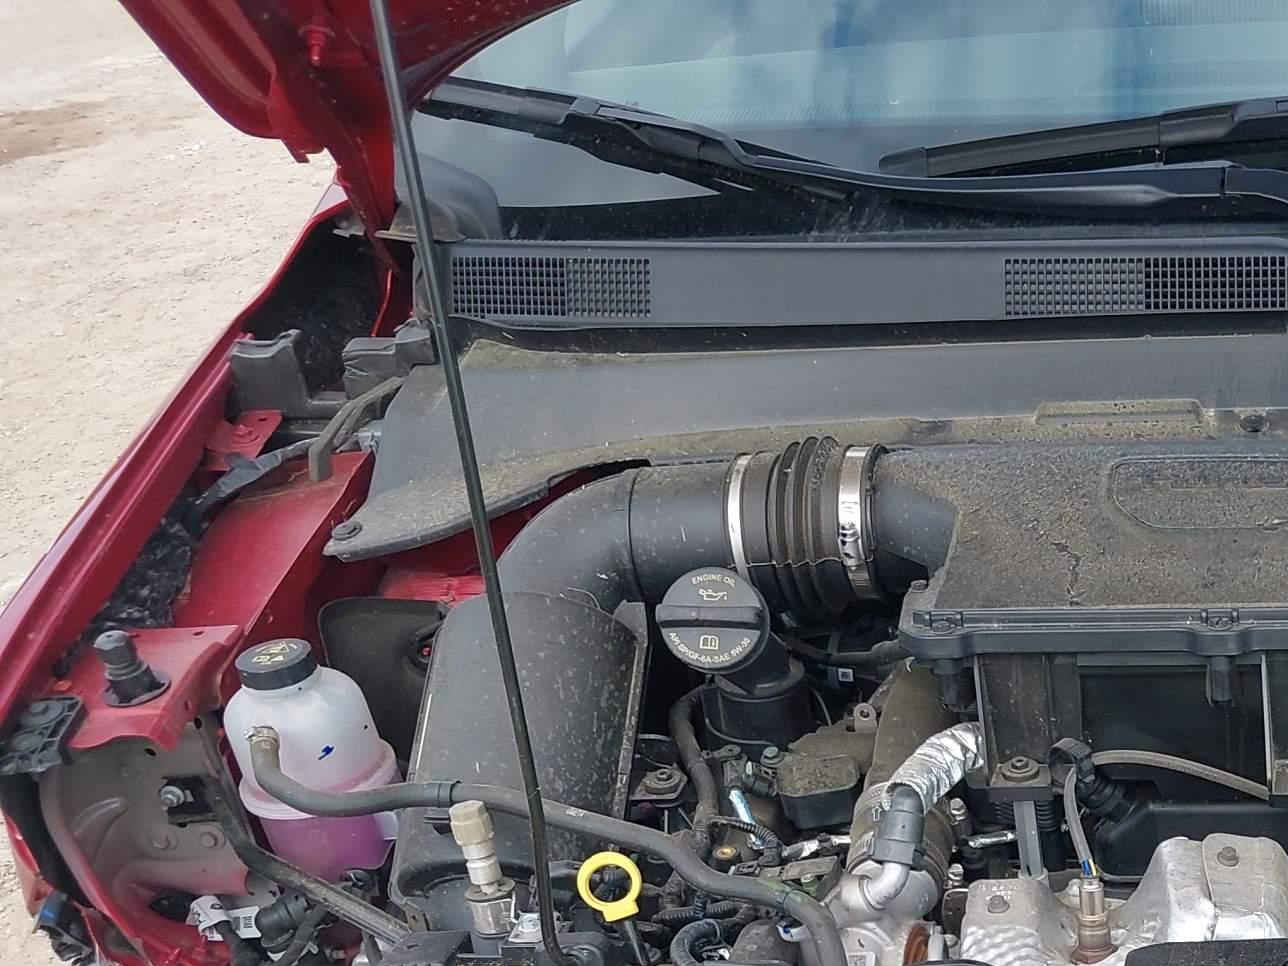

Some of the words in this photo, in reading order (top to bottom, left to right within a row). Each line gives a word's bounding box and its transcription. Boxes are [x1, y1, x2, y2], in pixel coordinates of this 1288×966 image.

[691, 574, 722, 585] ENGINE
[723, 575, 736, 588] OIL
[669, 632, 681, 646] API
[730, 637, 751, 657] 5W-30
